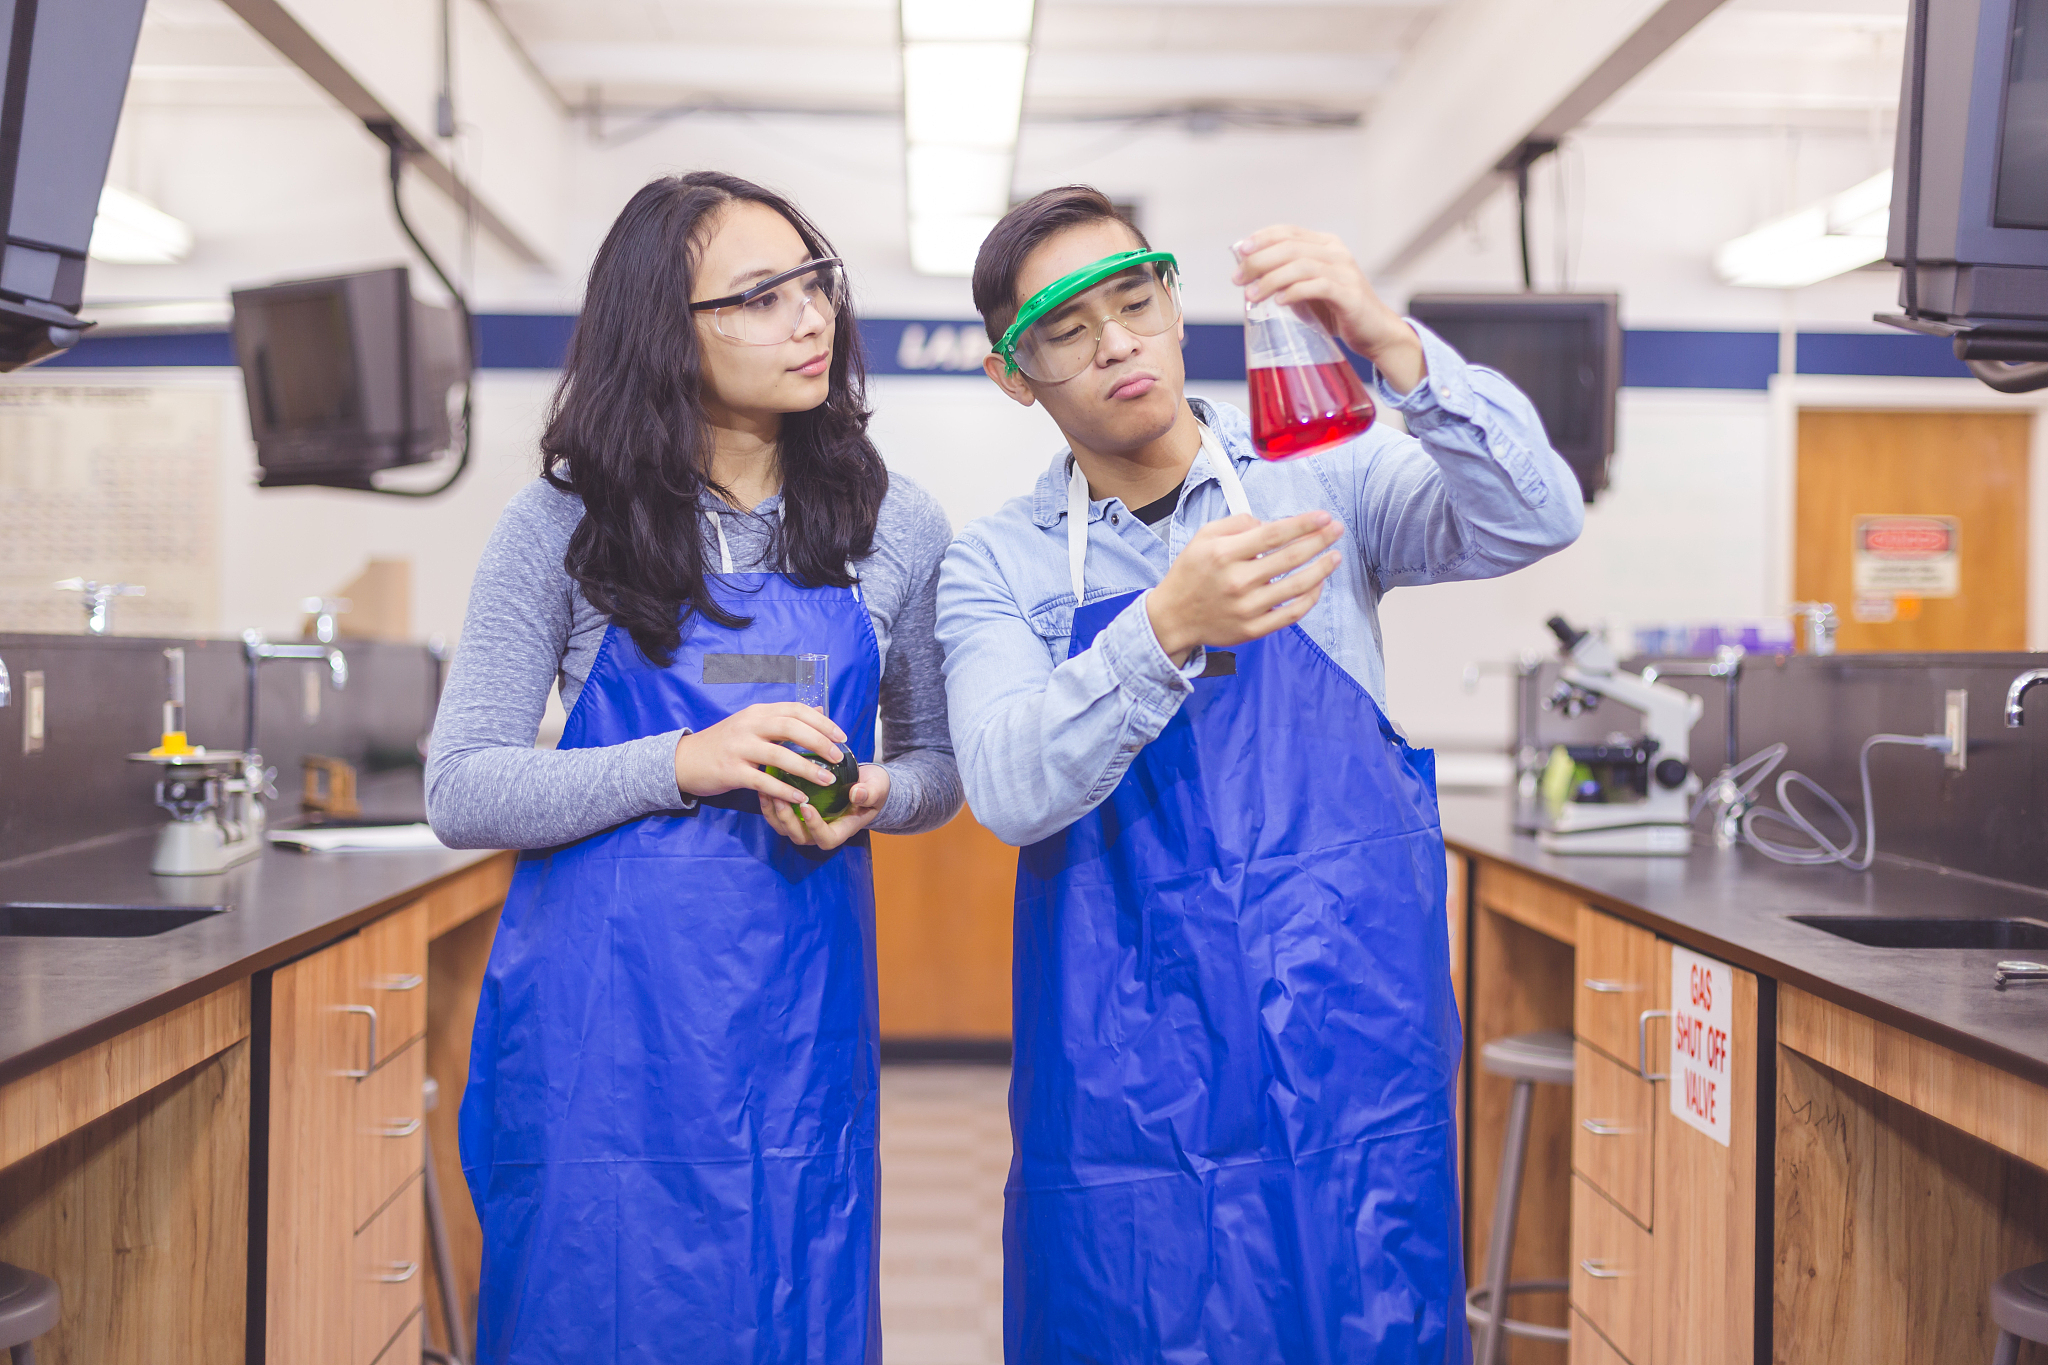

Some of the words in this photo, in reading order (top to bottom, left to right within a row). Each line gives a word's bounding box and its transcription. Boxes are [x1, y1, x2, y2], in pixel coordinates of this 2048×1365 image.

[1691, 963, 1713, 1011] GAS
[1677, 1010, 1703, 1062] SHUT
[1707, 1025, 1727, 1074] OFF
[1685, 1067, 1716, 1125] VALVE
